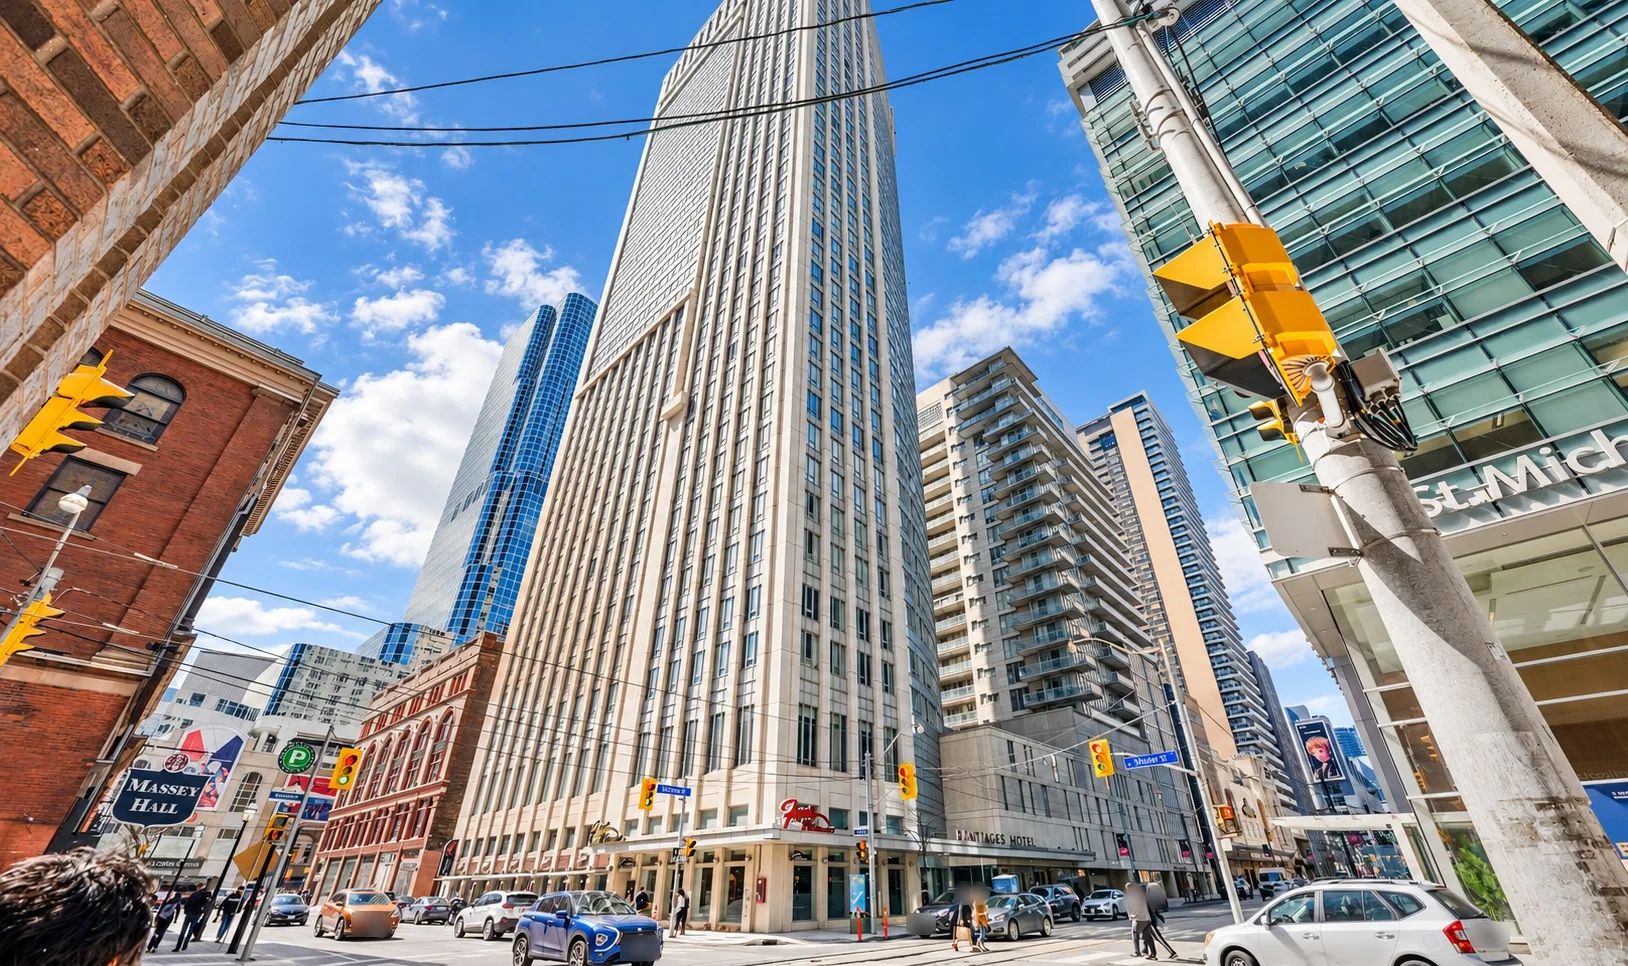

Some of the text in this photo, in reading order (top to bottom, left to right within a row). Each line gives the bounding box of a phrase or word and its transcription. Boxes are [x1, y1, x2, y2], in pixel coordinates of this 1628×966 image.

[288, 749, 306, 764] P
[126, 778, 200, 797] MASSEY
[128, 797, 178, 814] HALL
[1009, 835, 1037, 848] HOTEL
